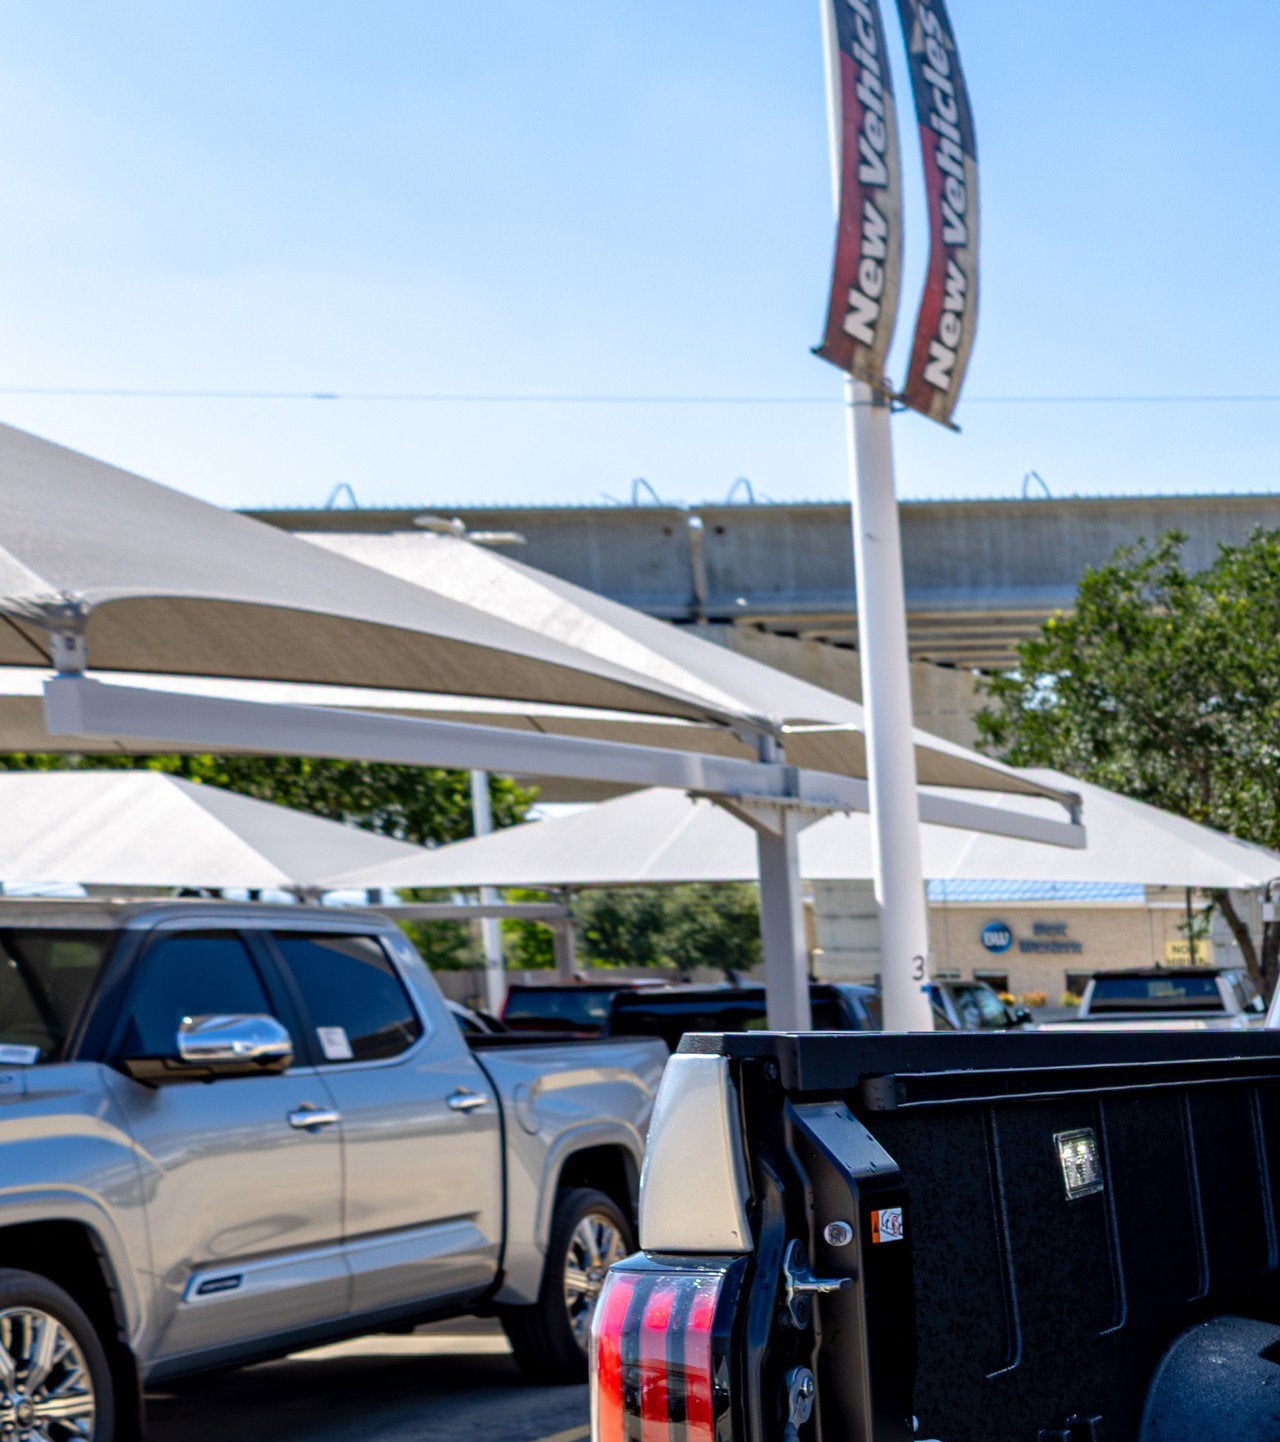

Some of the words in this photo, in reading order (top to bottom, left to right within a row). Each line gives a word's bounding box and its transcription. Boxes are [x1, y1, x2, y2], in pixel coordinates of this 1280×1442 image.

[849, 0, 887, 187] Vehicl
[919, 2, 967, 246] Vehicles
[843, 200, 888, 346] New
[924, 257, 967, 391] New
[912, 955, 925, 981] 3
[983, 931, 1010, 947] BW
